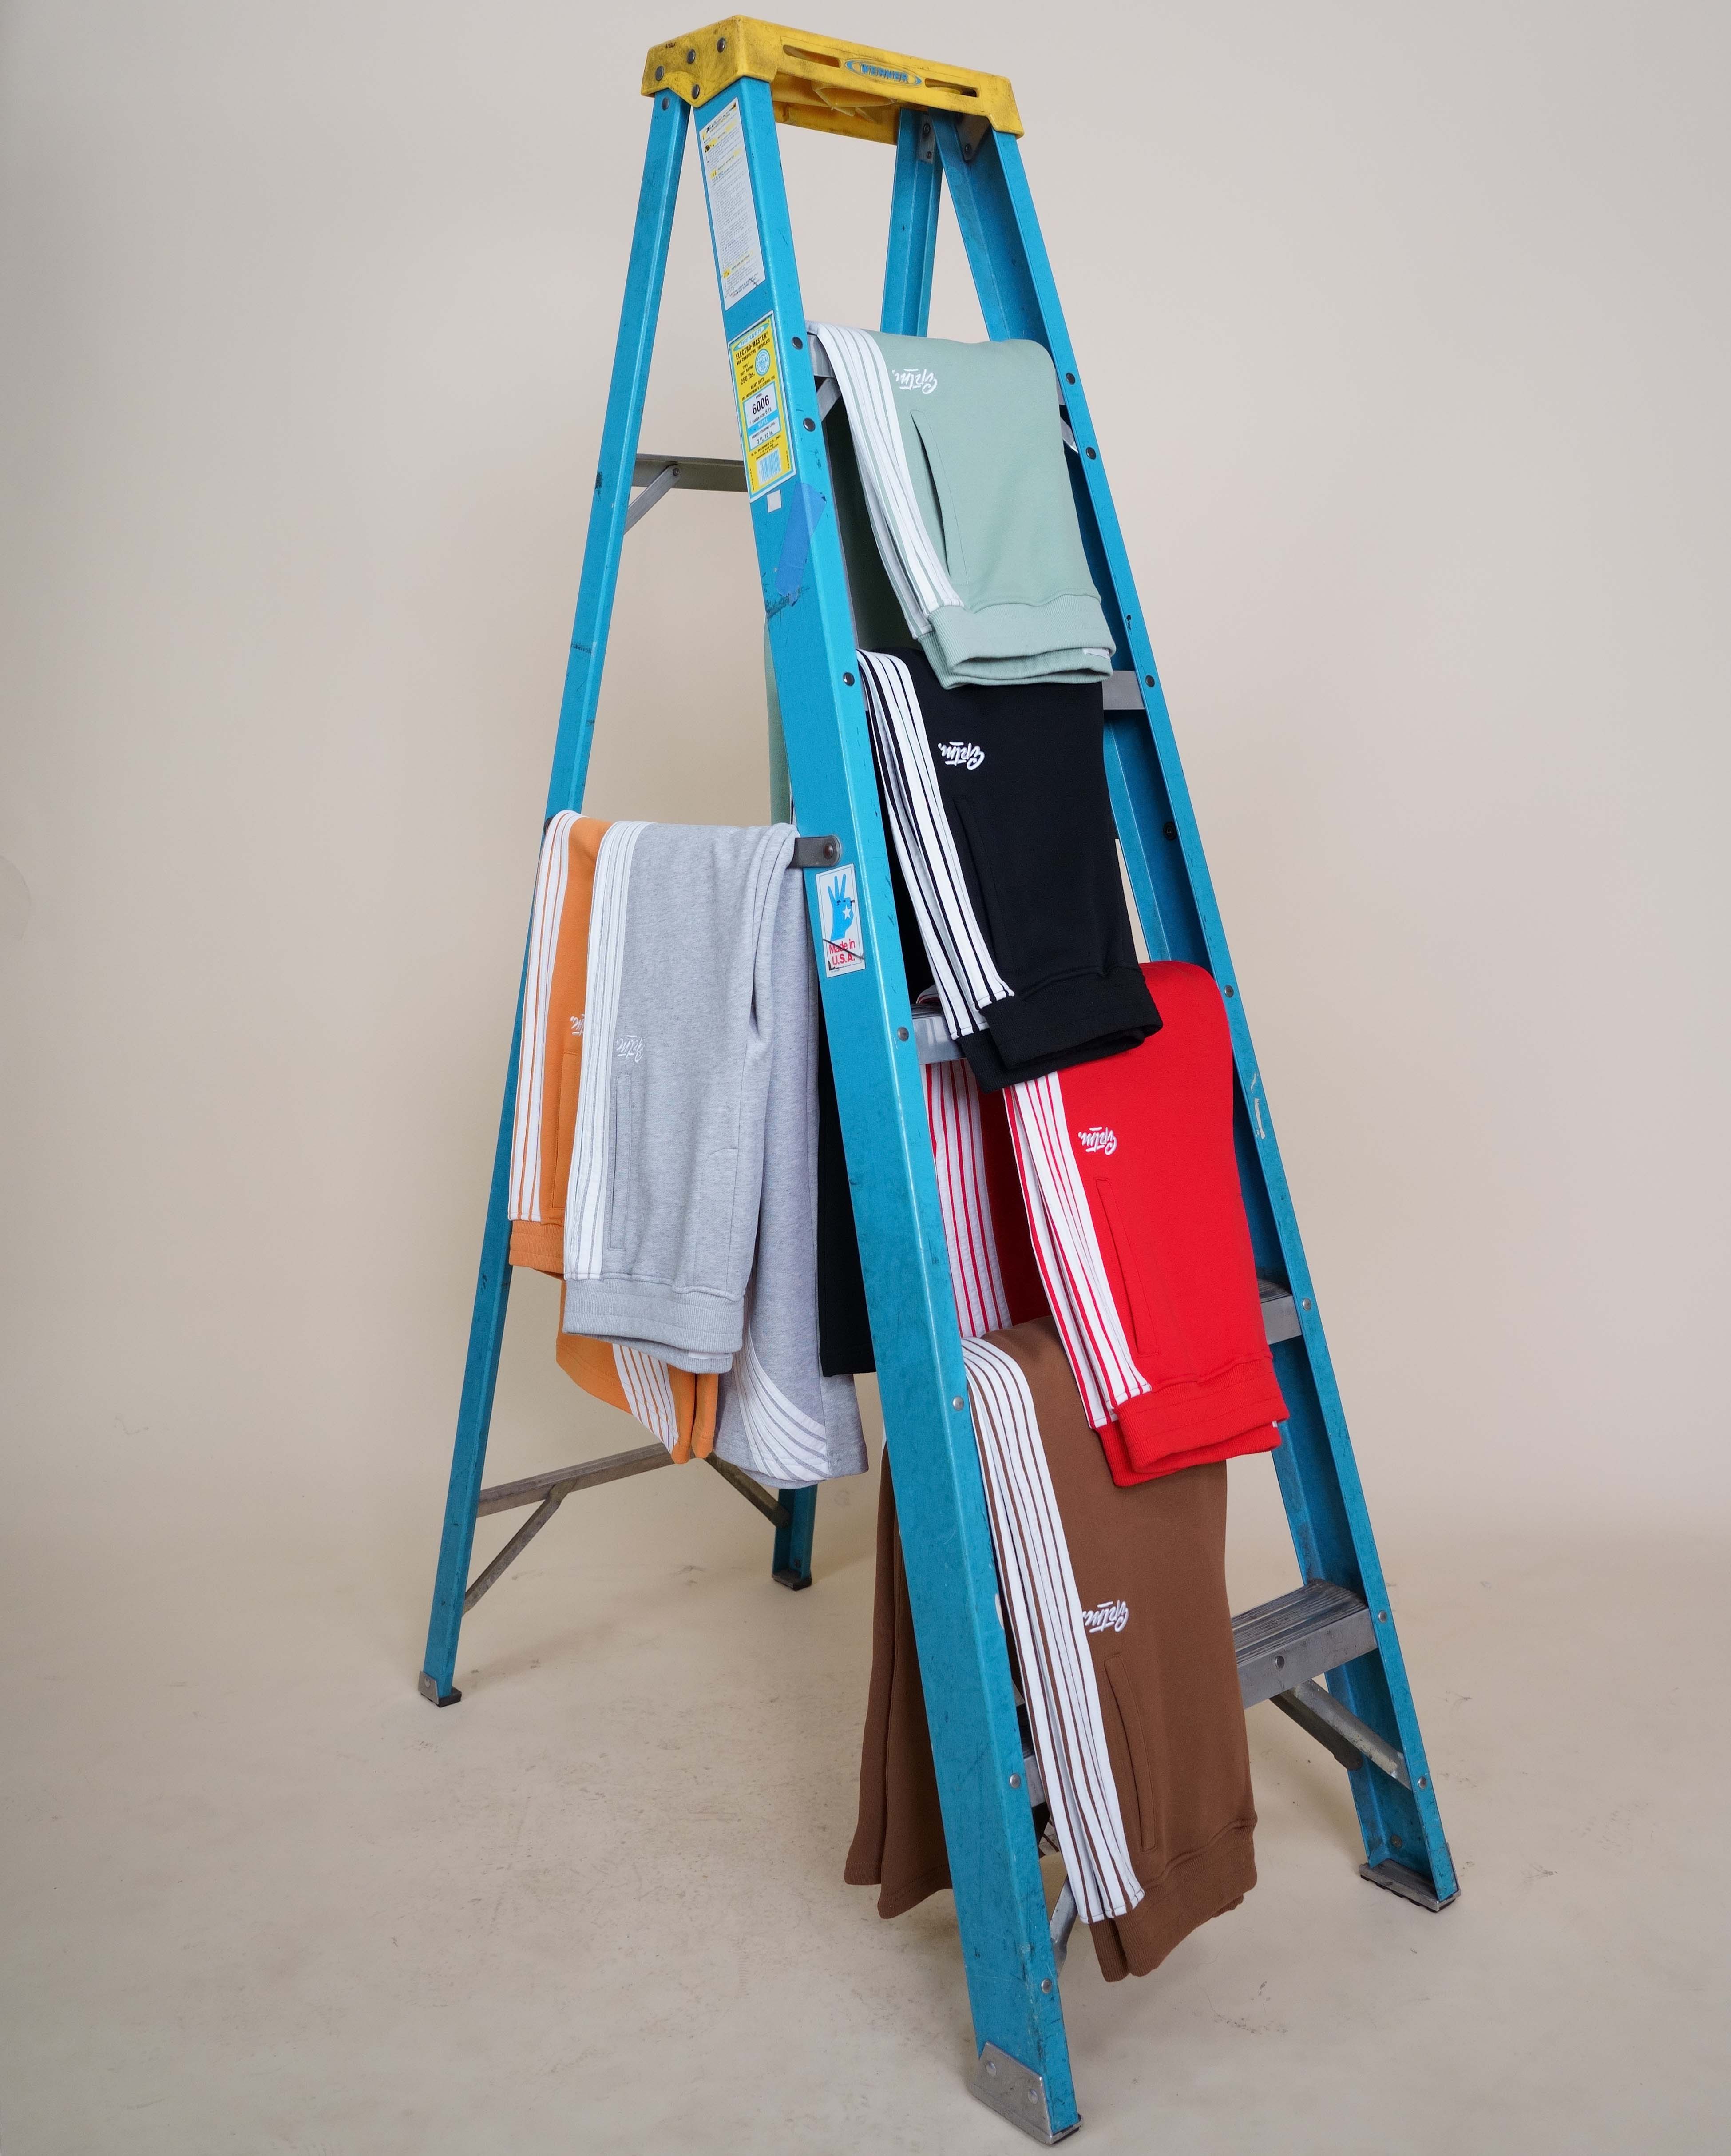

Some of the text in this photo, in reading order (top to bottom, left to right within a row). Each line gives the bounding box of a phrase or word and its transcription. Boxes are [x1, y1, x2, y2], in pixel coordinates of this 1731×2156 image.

[860, 63, 909, 84] WERNER
[752, 395, 769, 415] 6006
[829, 939, 856, 954] Made in
[832, 953, 856, 965] U.S.A.
